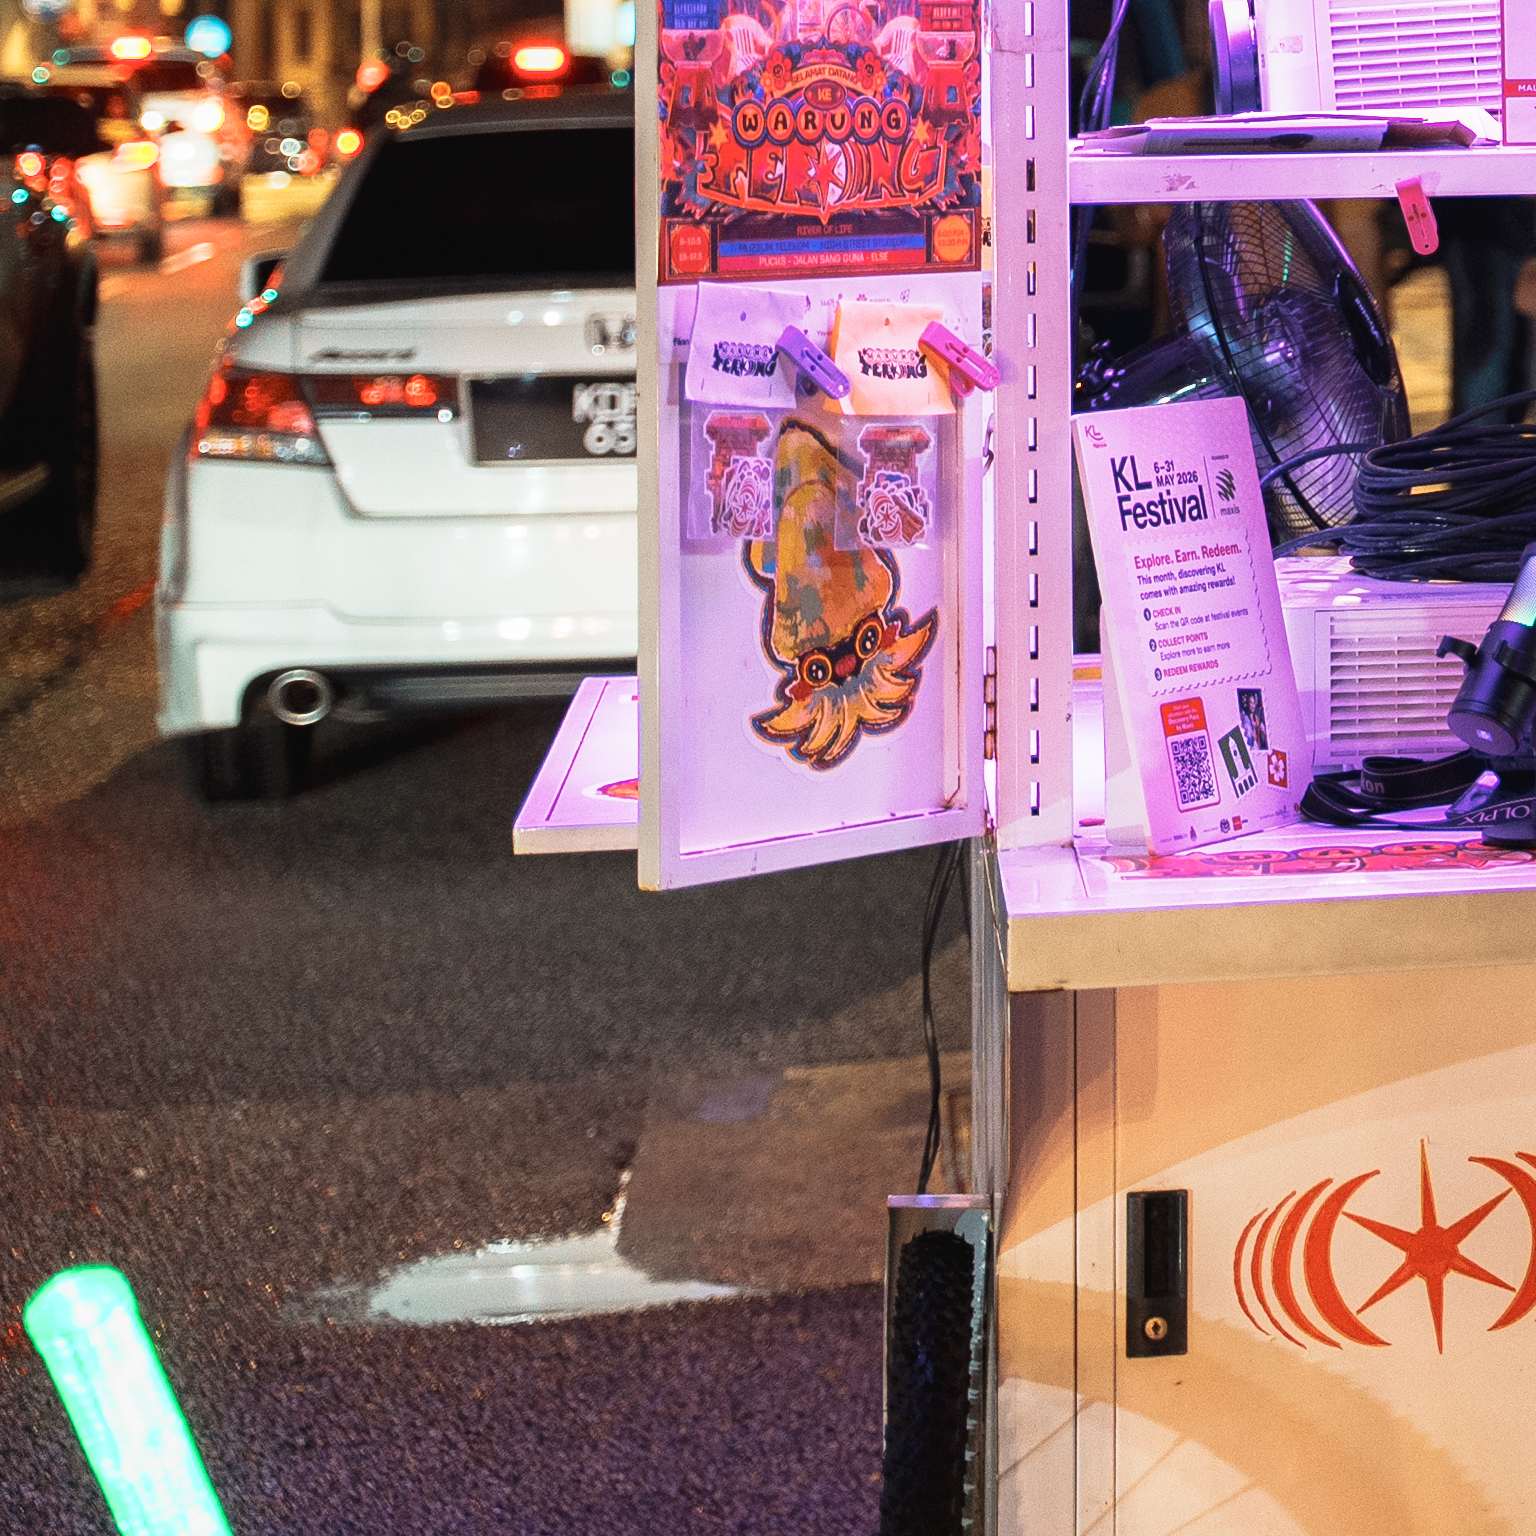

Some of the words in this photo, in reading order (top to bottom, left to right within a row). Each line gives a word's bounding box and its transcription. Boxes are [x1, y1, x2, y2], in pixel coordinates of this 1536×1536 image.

[791, 67, 826, 86] SELAMAT
[828, 67, 858, 86] DATANG
[741, 109, 902, 132] WARUNG
[793, 254, 818, 265] JALAN
[820, 254, 841, 264] SANG
[1110, 455, 1152, 493] KL
[1156, 474, 1175, 487] MAY
[1177, 471, 1198, 484] 2026
[1117, 485, 1208, 531] Festival
[1220, 505, 1240, 516] maxis
[1134, 553, 1174, 571] Explore.
[1174, 548, 1200, 563] Earn.
[1201, 543, 1242, 559] Redeem.
[1137, 574, 1152, 585] This
[1153, 570, 1177, 583] month,
[1178, 565, 1216, 579] discovering
[1216, 562, 1226, 573] KL
[1140, 589, 1162, 600] comes
[1163, 585, 1178, 596] with
[1179, 581, 1207, 594] amazing
[1207, 576, 1236, 589] rewards!
[1152, 607, 1174, 618] CHECK
[1174, 606, 1181, 615] IN
[1155, 622, 1169, 631] Scan
[1170, 619, 1179, 628] the
[1190, 615, 1204, 624] code
[1211, 609, 1230, 621] festival
[1231, 608, 1248, 618] events
[1158, 635, 1185, 648] COLLECT
[1186, 632, 1208, 644] POINTS
[1160, 650, 1181, 661] Explore
[1182, 648, 1196, 656] more
[1203, 645, 1216, 654] earn
[1216, 642, 1230, 650] more
[1163, 665, 1188, 677] REDEEM
[1189, 659, 1219, 672] REWARDS
[1360, 771, 1386, 795] kon
[1458, 804, 1531, 826] OLPIX
